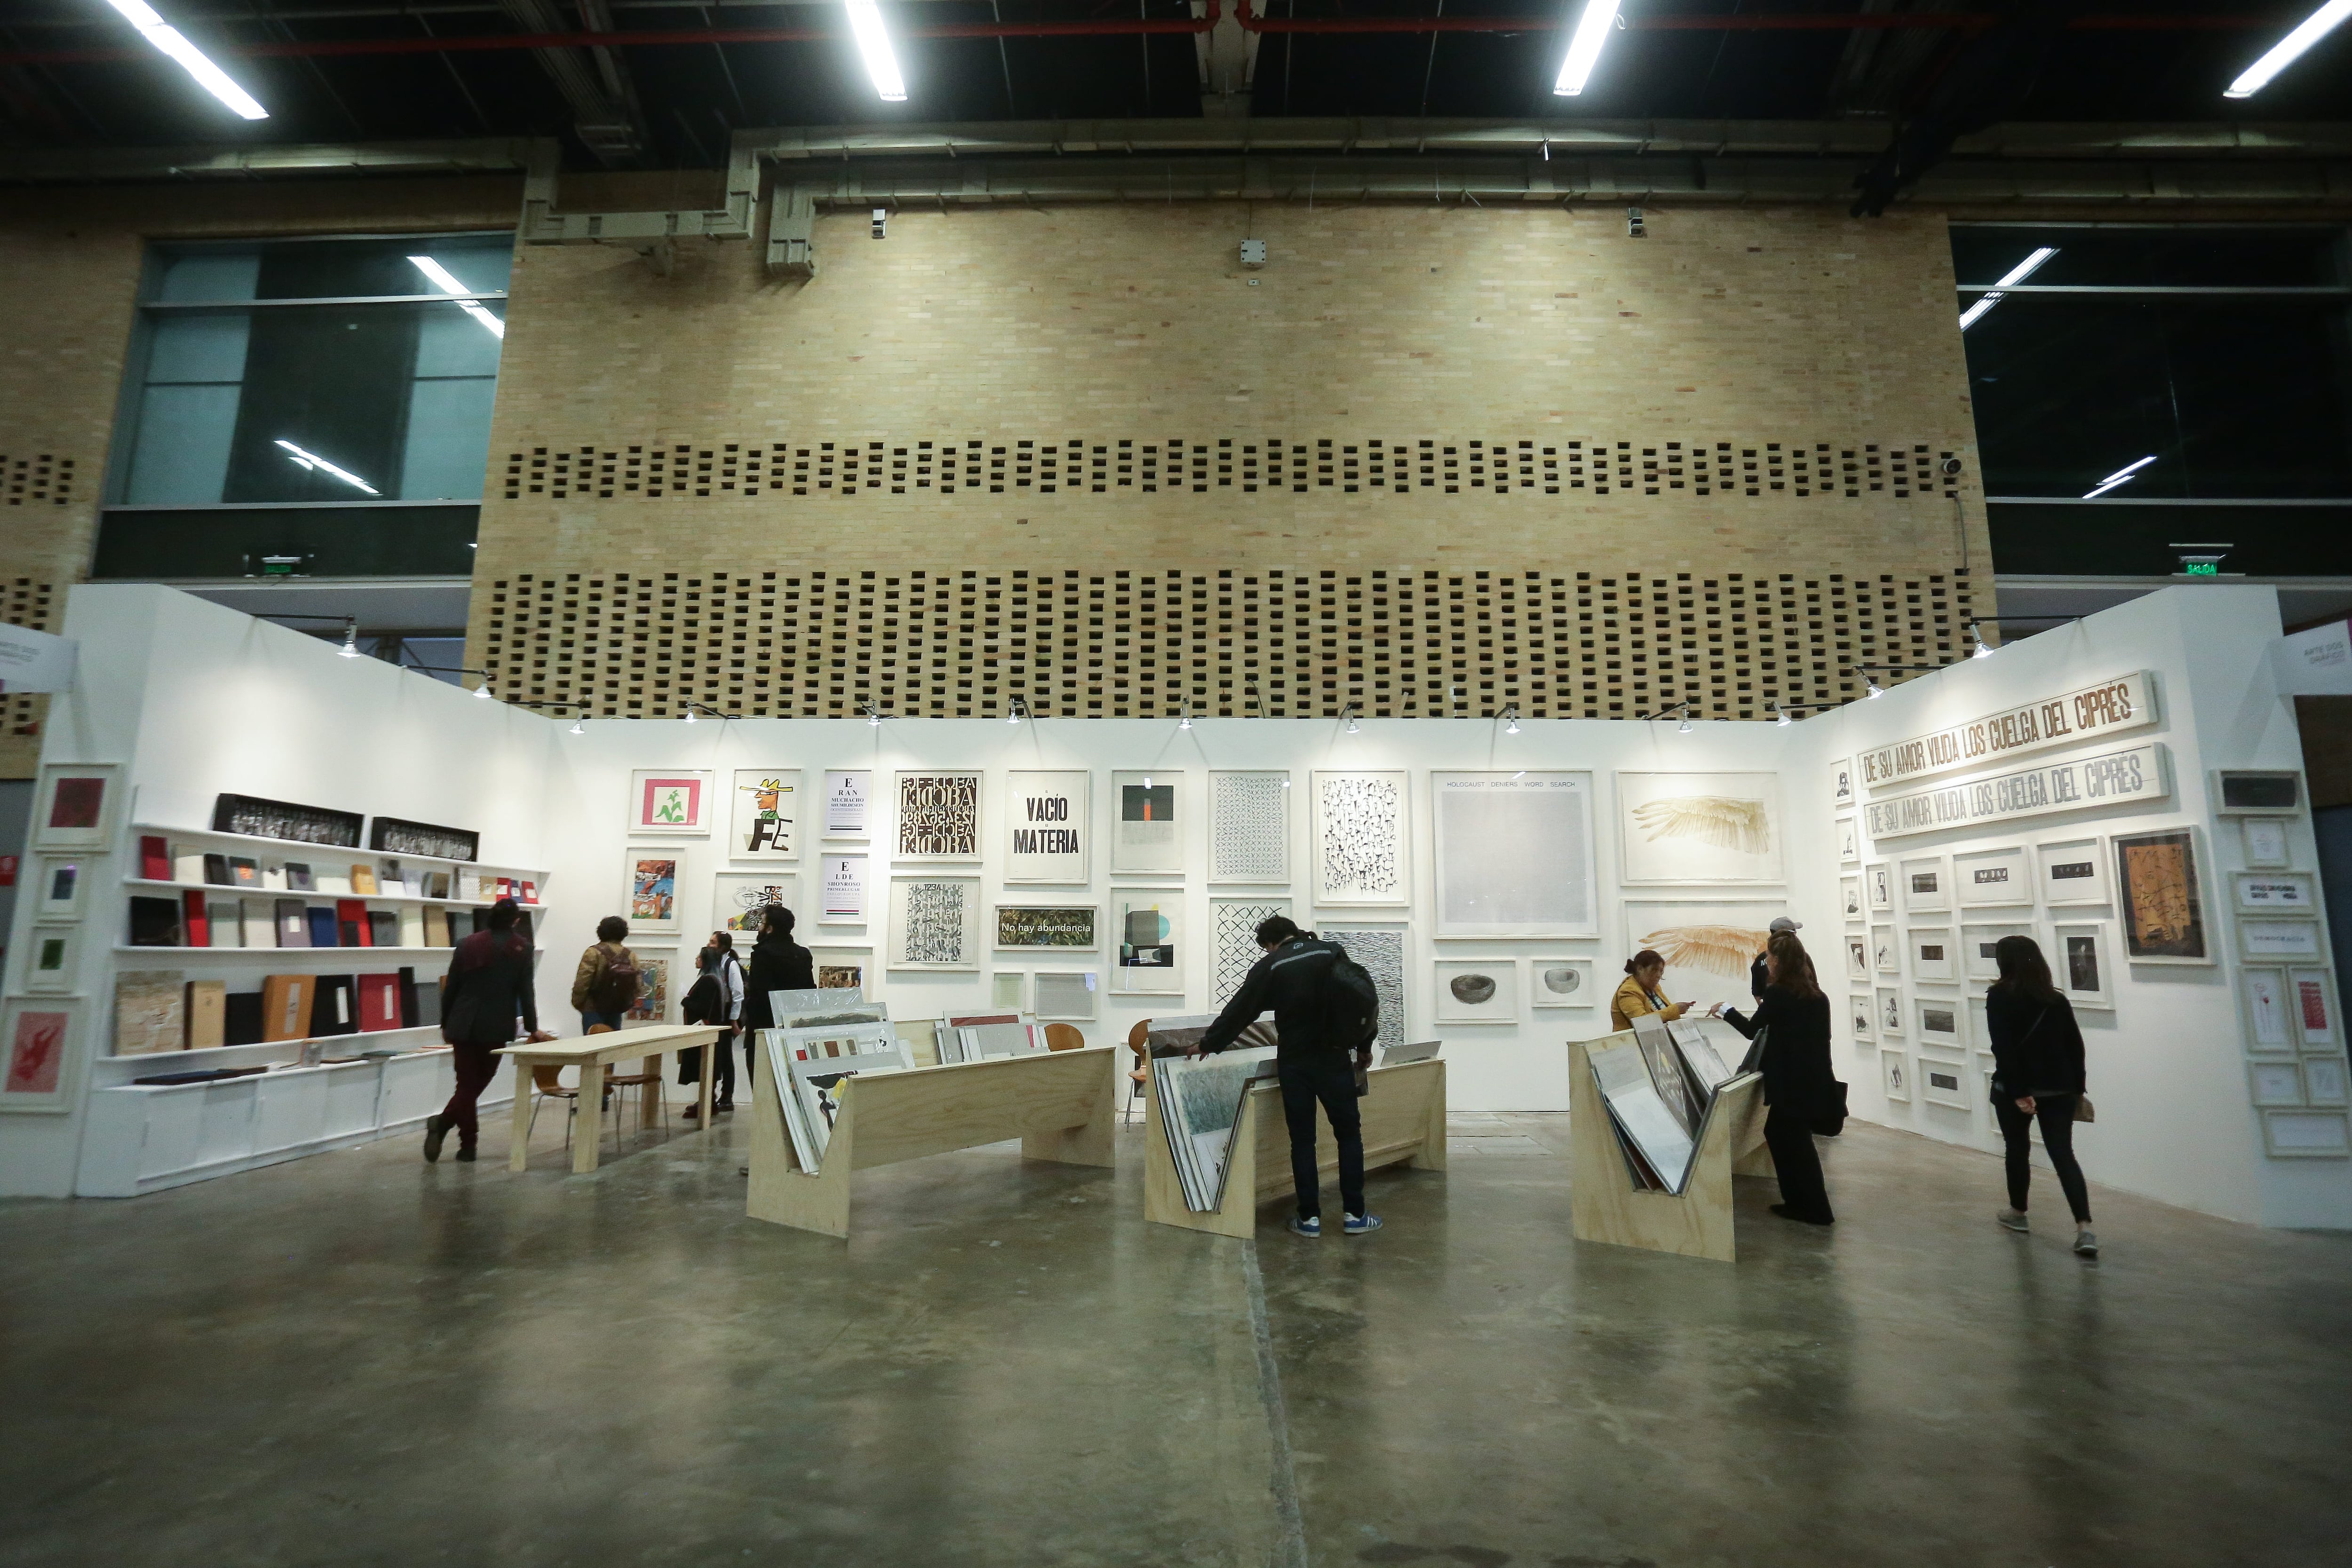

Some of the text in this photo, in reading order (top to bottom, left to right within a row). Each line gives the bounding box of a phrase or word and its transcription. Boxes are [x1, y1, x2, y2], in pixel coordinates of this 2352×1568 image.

[2188, 564, 2216, 573] SALIDA
[1864, 754, 1877, 783] DE
[1879, 749, 1893, 779] SU
[1896, 741, 1926, 775] AMOR
[1927, 732, 1960, 767] VIUDA
[1962, 724, 1986, 758] LOS
[1989, 709, 2040, 751] CUELGA
[2042, 701, 2072, 738] DEL
[845, 778, 852, 787] E
[1026, 793, 1067, 821] VACÍO
[1870, 806, 1883, 833] DE
[1885, 802, 1899, 831] SU
[1902, 796, 1932, 829] AMOR
[1934, 789, 1967, 823] VIUDA
[1969, 783, 1994, 817] LOS
[1997, 772, 2048, 811] CUELGA
[2051, 767, 2081, 803] DEL
[1014, 829, 1079, 853] MATERIA
[841, 862, 849, 871] E
[1018, 923, 1034, 934] hay
[1037, 923, 1091, 932] abundancia
